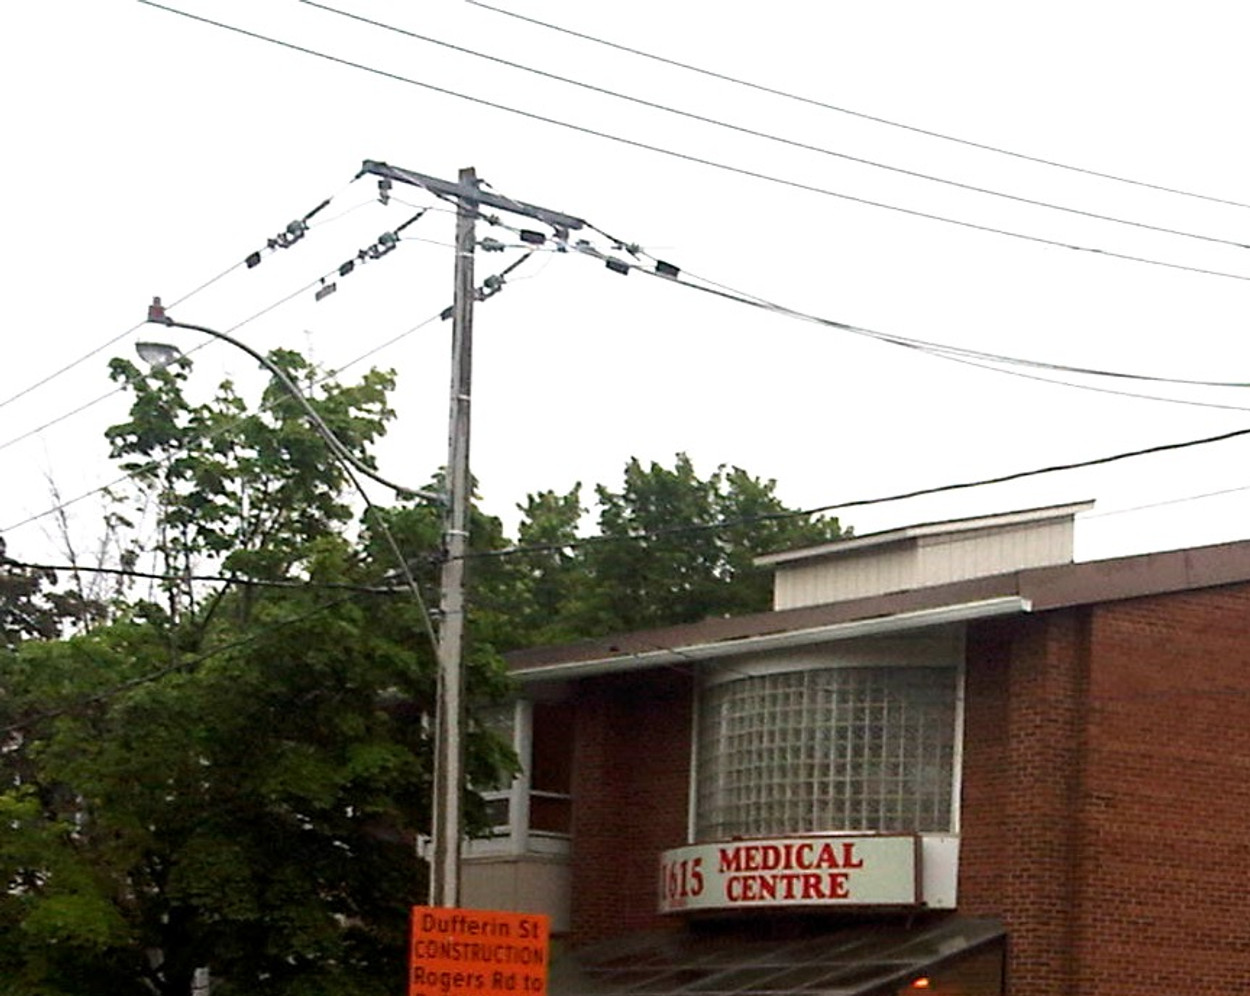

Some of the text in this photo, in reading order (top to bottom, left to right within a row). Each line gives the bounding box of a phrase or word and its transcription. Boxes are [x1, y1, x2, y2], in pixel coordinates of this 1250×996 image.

[718, 842, 864, 873] MEDICAL
[726, 873, 850, 901] CENTRE
[422, 913, 539, 939] Dufferin St
[415, 940, 544, 965] CONSTRUCTION
[414, 966, 543, 992] Rogers Rd to
